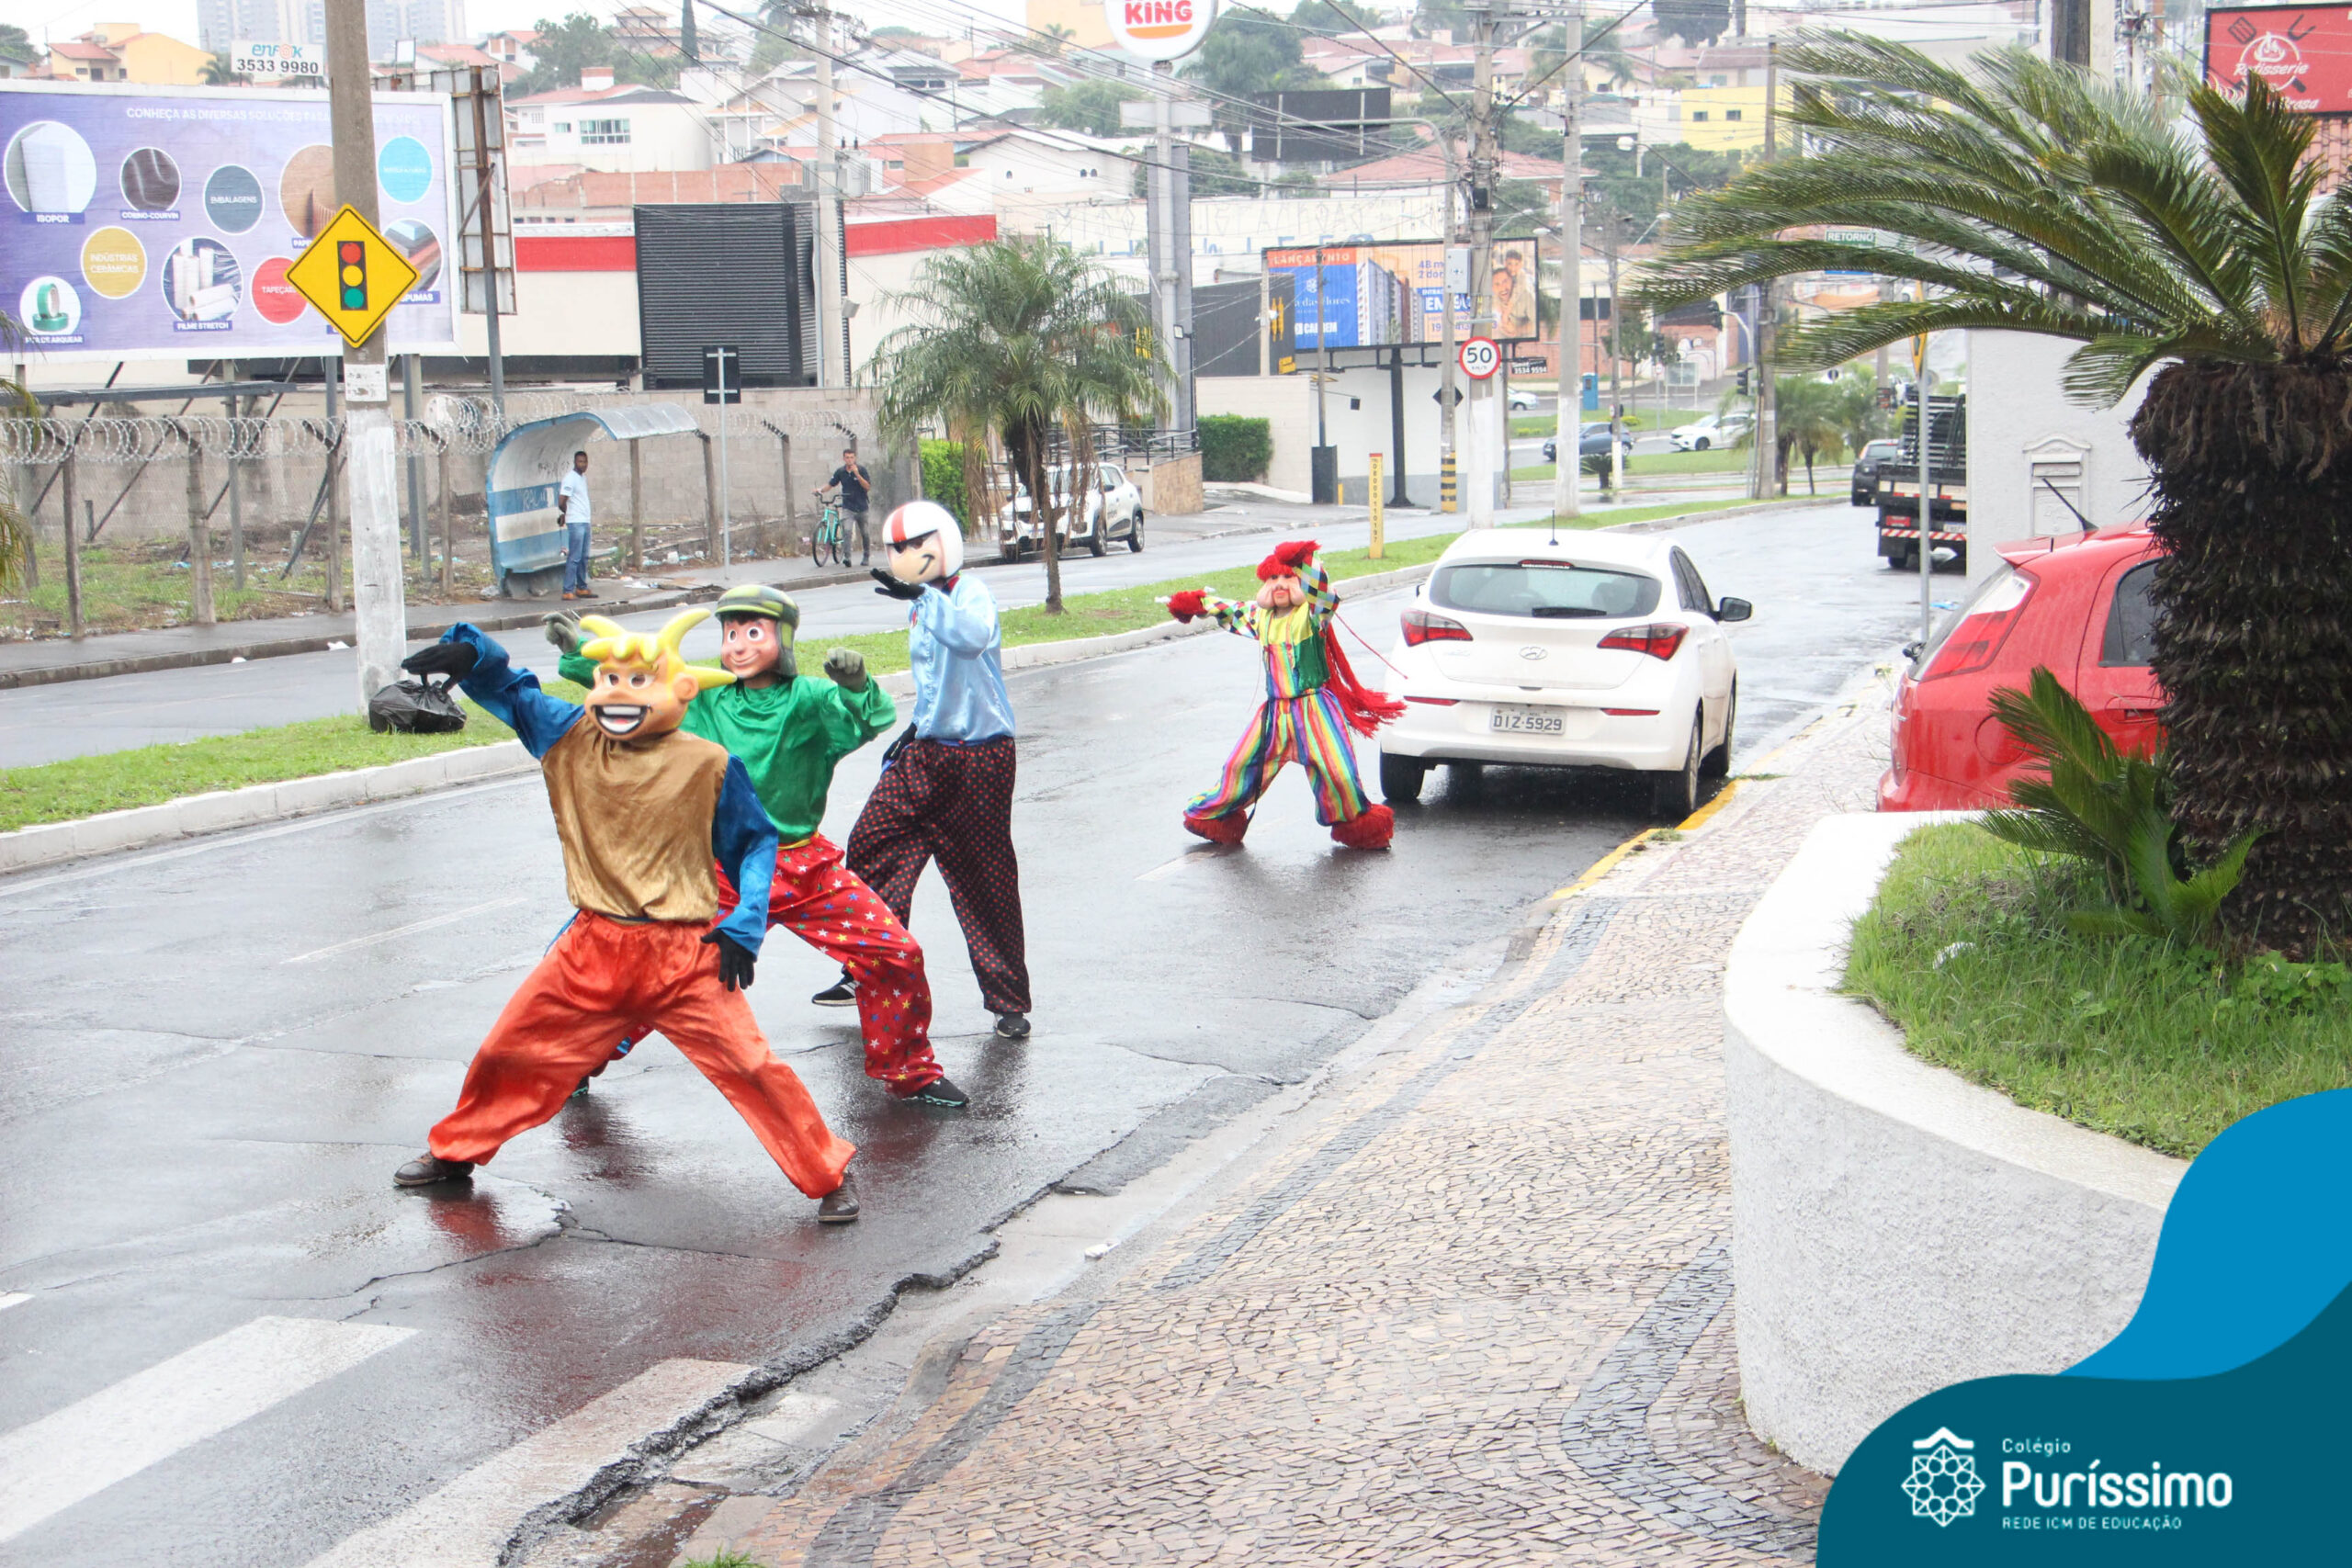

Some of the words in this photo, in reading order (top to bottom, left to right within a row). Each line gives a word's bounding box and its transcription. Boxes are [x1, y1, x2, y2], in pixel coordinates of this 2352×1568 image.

[1125, 1, 1193, 24] KING
[237, 59, 276, 72] 3533
[280, 61, 319, 73] 9980
[183, 109, 198, 118] AS
[36, 214, 70, 223] ISOPOR
[1827, 231, 1874, 242] RETORNO
[1467, 347, 1492, 364] 50
